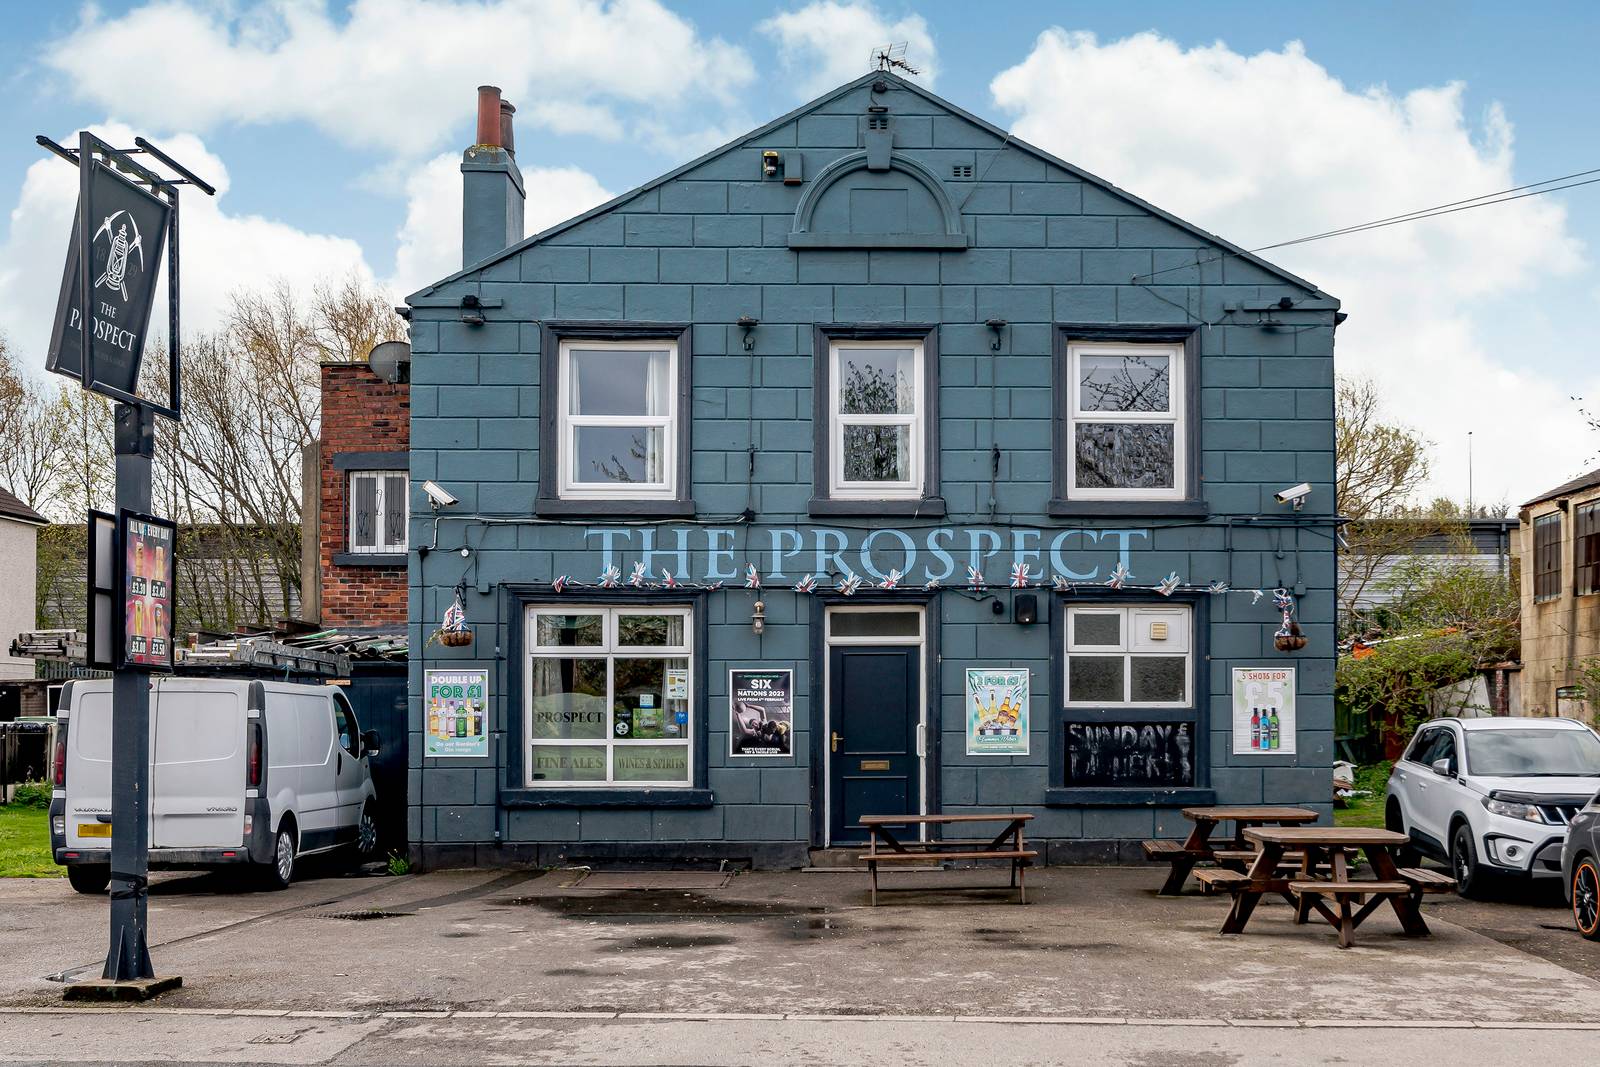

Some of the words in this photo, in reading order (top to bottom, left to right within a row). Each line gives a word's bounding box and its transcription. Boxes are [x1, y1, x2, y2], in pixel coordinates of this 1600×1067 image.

[100, 301, 117, 319] THE
[69, 307, 136, 351] PSPECT
[583, 529, 738, 579] THE
[766, 528, 1148, 580] PROSPECT
[431, 675, 468, 684] DOUBLE
[469, 675, 482, 684] UP
[984, 675, 1006, 686] FOR
[1242, 672, 1246, 680] 5
[1248, 672, 1270, 680] SHOTS
[1272, 672, 1286, 680] FOR
[750, 678, 772, 689] SIX
[431, 685, 464, 698] FOR
[467, 685, 482, 698] £1
[1244, 681, 1284, 712] £5
[537, 711, 604, 723] PROSPECT
[537, 757, 568, 769] FINE
[570, 757, 604, 769] ALES
[618, 757, 645, 769] WINES
[652, 757, 685, 769] SPIRITS
